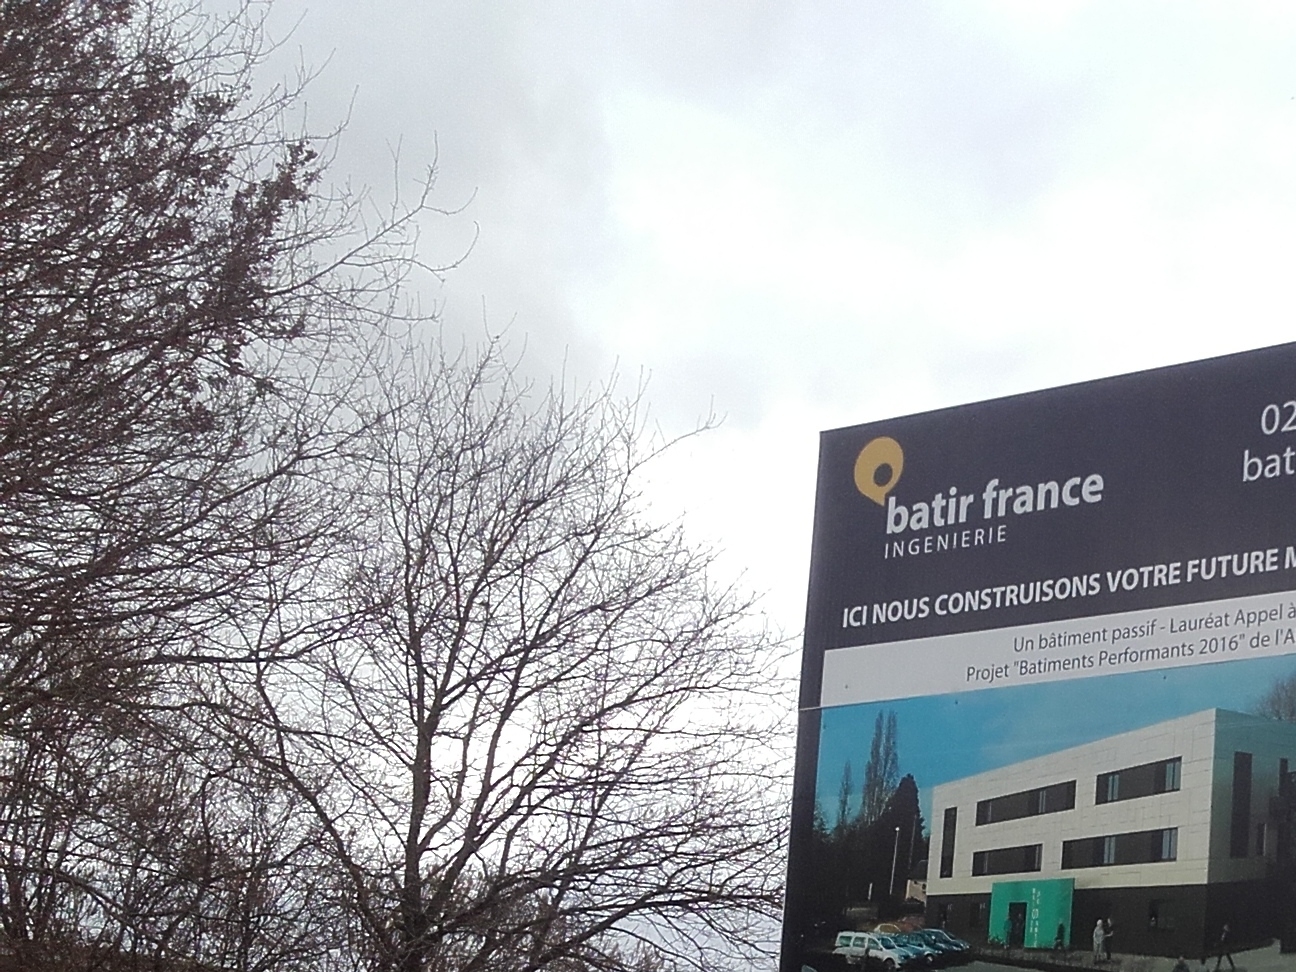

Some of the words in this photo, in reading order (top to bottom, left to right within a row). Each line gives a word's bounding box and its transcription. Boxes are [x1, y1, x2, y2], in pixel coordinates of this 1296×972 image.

[886, 492, 974, 535] batir
[982, 473, 1104, 520] france
[884, 524, 1008, 560] INGENIERIE
[842, 605, 868, 628] ICI
[872, 596, 930, 625] NOUS
[934, 573, 1101, 616] CONSTRUISONS
[1106, 561, 1182, 593] VOTRE
[1186, 548, 1279, 583] FUTURE
[1013, 636, 1034, 653] Un
[1038, 627, 1108, 650] bâtiment
[1111, 618, 1158, 645] passif
[1169, 612, 1230, 634] Lauréat
[1233, 603, 1284, 629] Appel
[1287, 602, 1296, 619] à
[966, 663, 1010, 684] Projet
[1013, 654, 1095, 676] "Batiments
[1098, 642, 1195, 667] Performants
[1198, 633, 1246, 655] 2016"
[1249, 631, 1271, 649] de
